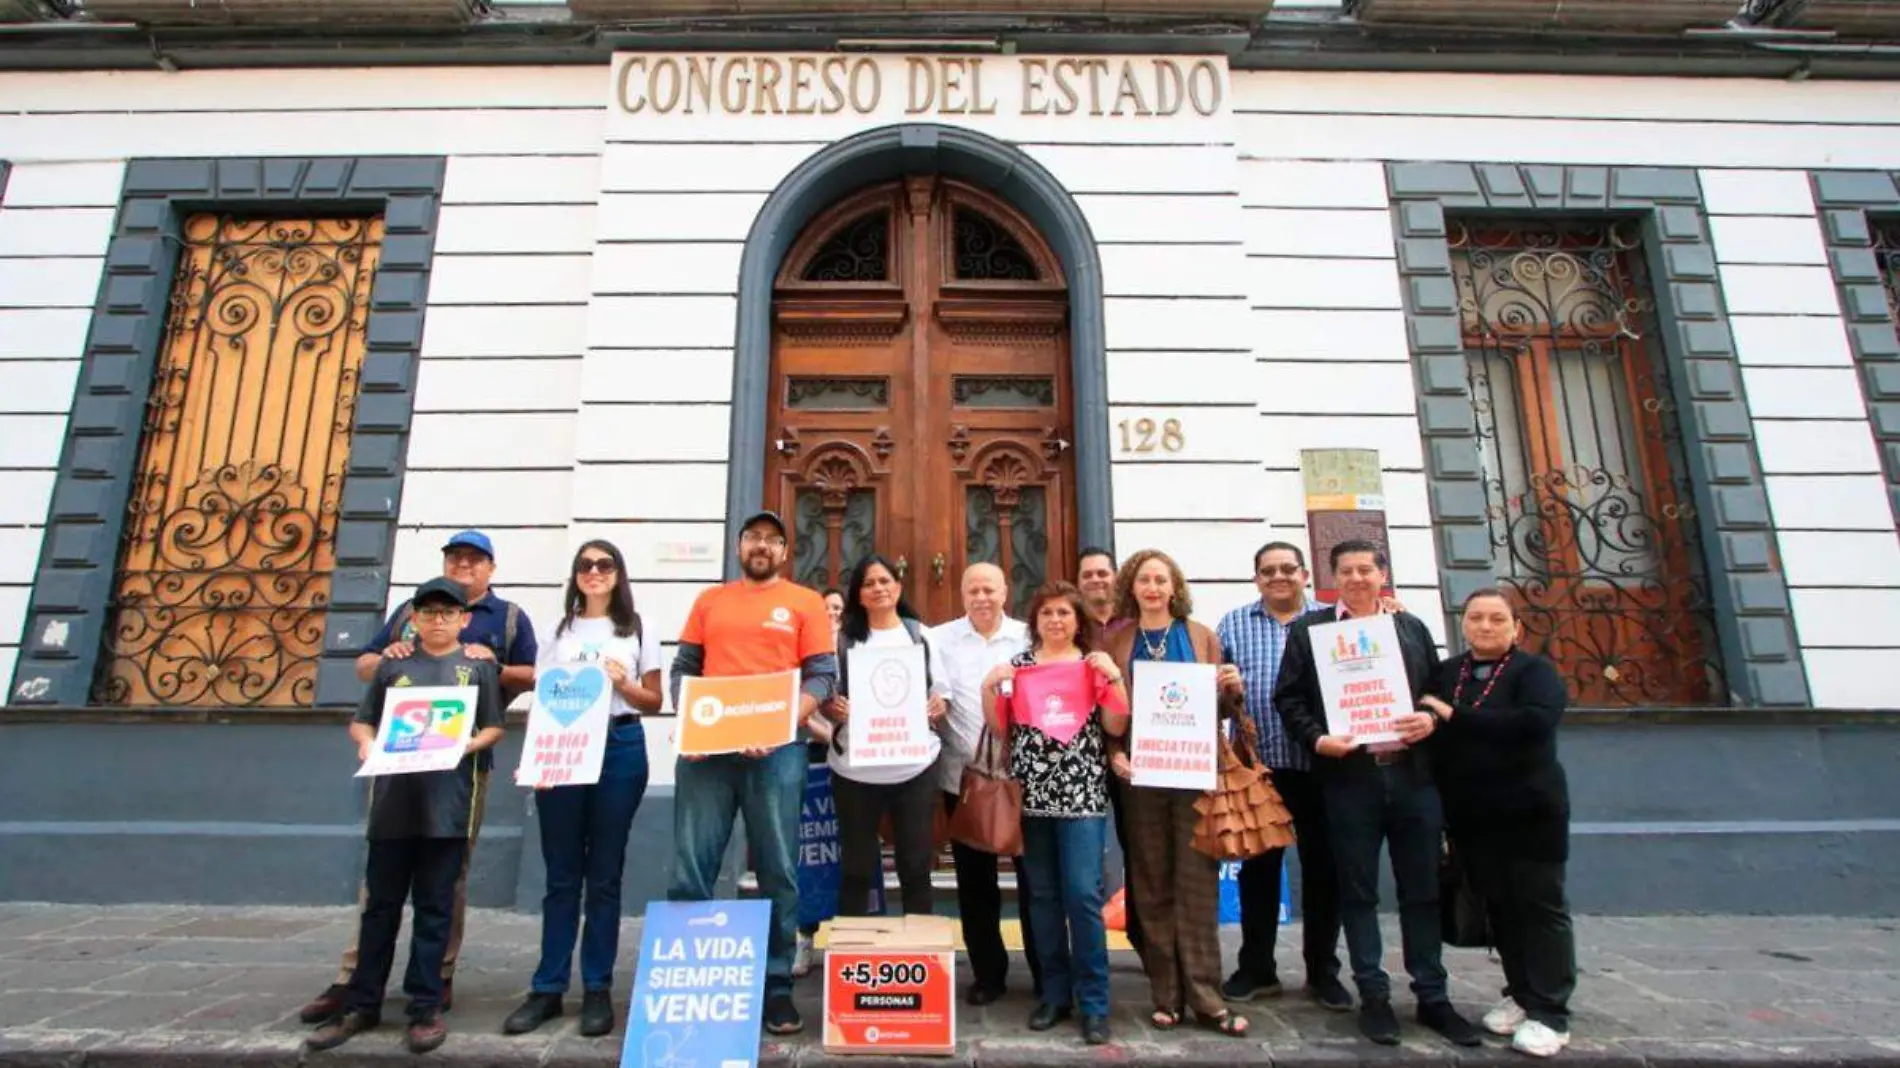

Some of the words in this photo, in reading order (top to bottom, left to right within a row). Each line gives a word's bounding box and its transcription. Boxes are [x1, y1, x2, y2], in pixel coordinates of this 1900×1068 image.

[616, 56, 883, 116] CONGRESO
[904, 57, 998, 116] DEL
[1019, 58, 1224, 118] ESTADO
[1118, 417, 1184, 452] 128
[1343, 679, 1385, 694] FRENTE
[1339, 691, 1396, 710] NACIONAL
[1350, 708, 1372, 720] POR
[1136, 738, 1212, 755] INICIATIVA
[535, 750, 562, 765] POR
[565, 750, 584, 765] LA
[1134, 755, 1212, 772] CIUDADANA
[652, 936, 686, 961] LA
[693, 936, 755, 960] VIDA
[649, 965, 755, 989] SIEMPRE
[840, 961, 927, 990] +5,900
[645, 992, 753, 1023] VENCE
[860, 995, 915, 1006] PERSONAS
